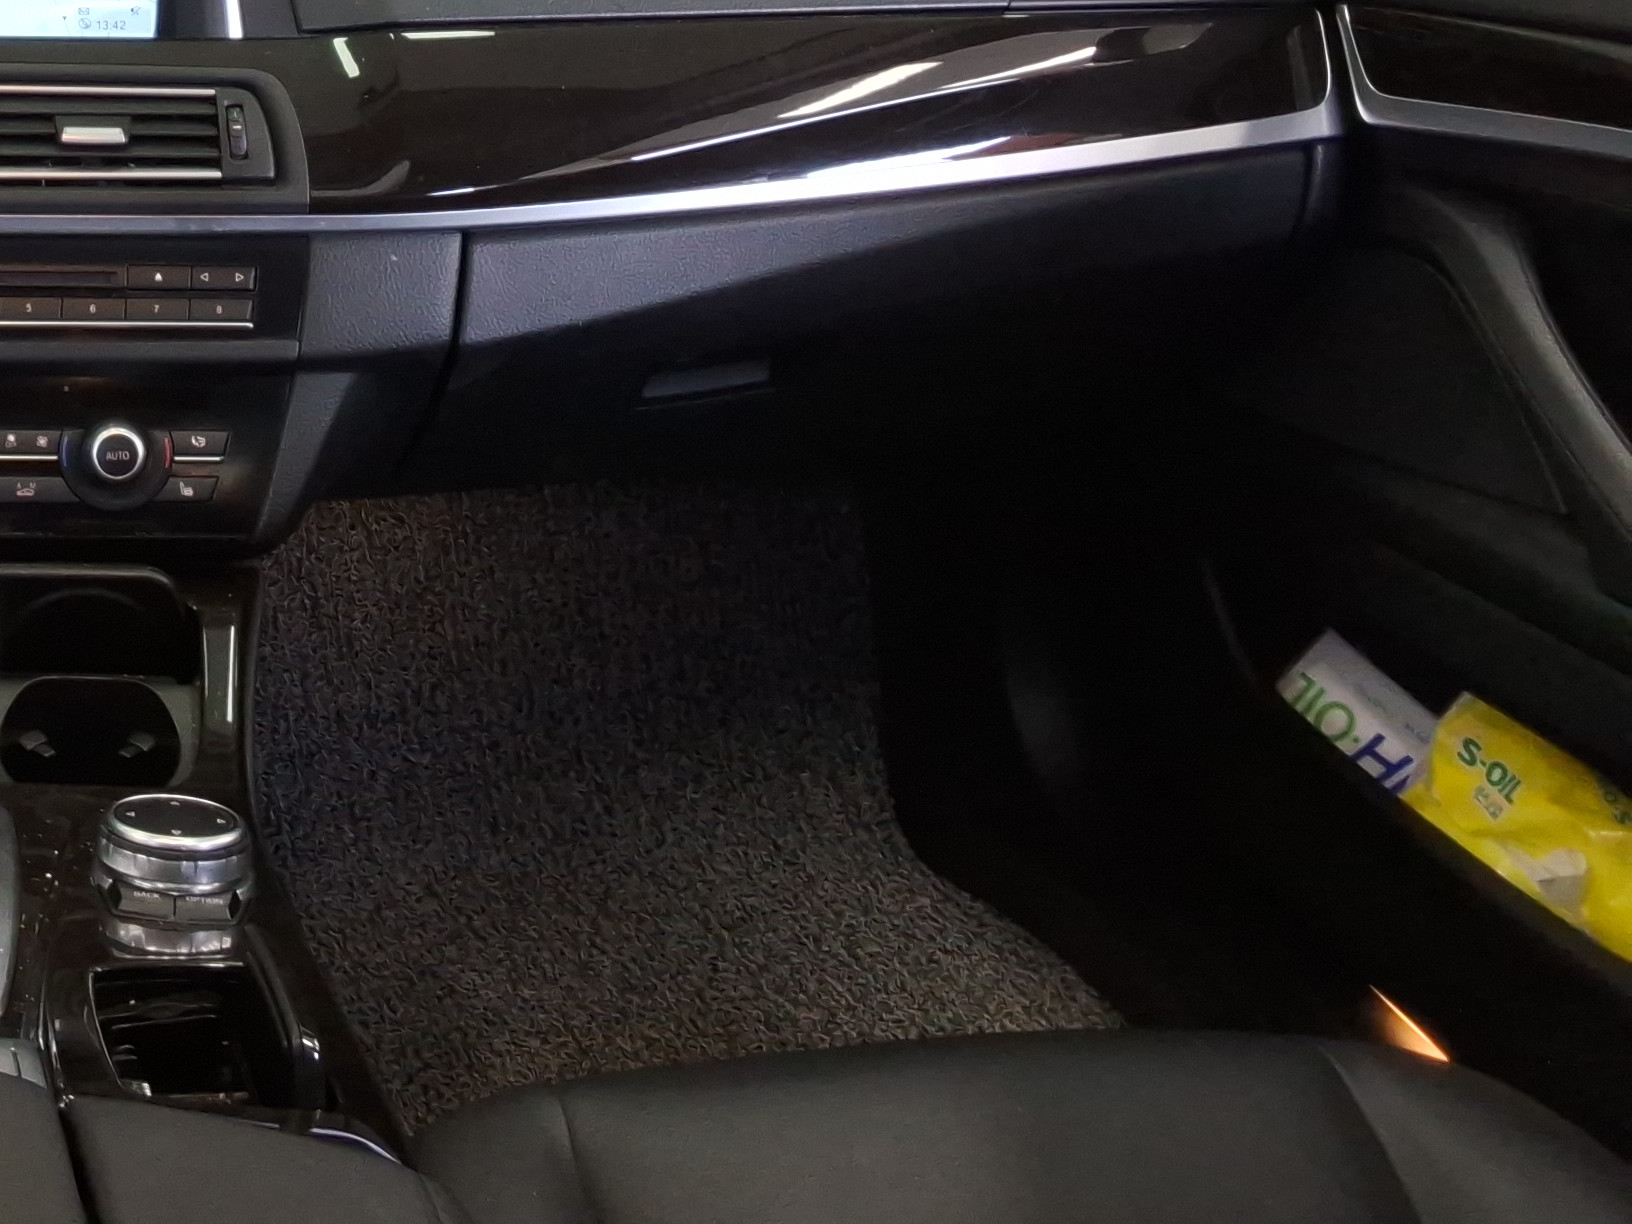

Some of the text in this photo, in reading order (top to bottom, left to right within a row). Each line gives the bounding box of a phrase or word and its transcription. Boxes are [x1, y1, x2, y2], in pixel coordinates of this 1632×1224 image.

[96, 20, 127, 30] 13:42
[105, 449, 131, 462] AUTO
[1456, 736, 1522, 806] S-OIL
[133, 890, 161, 900] BACK
